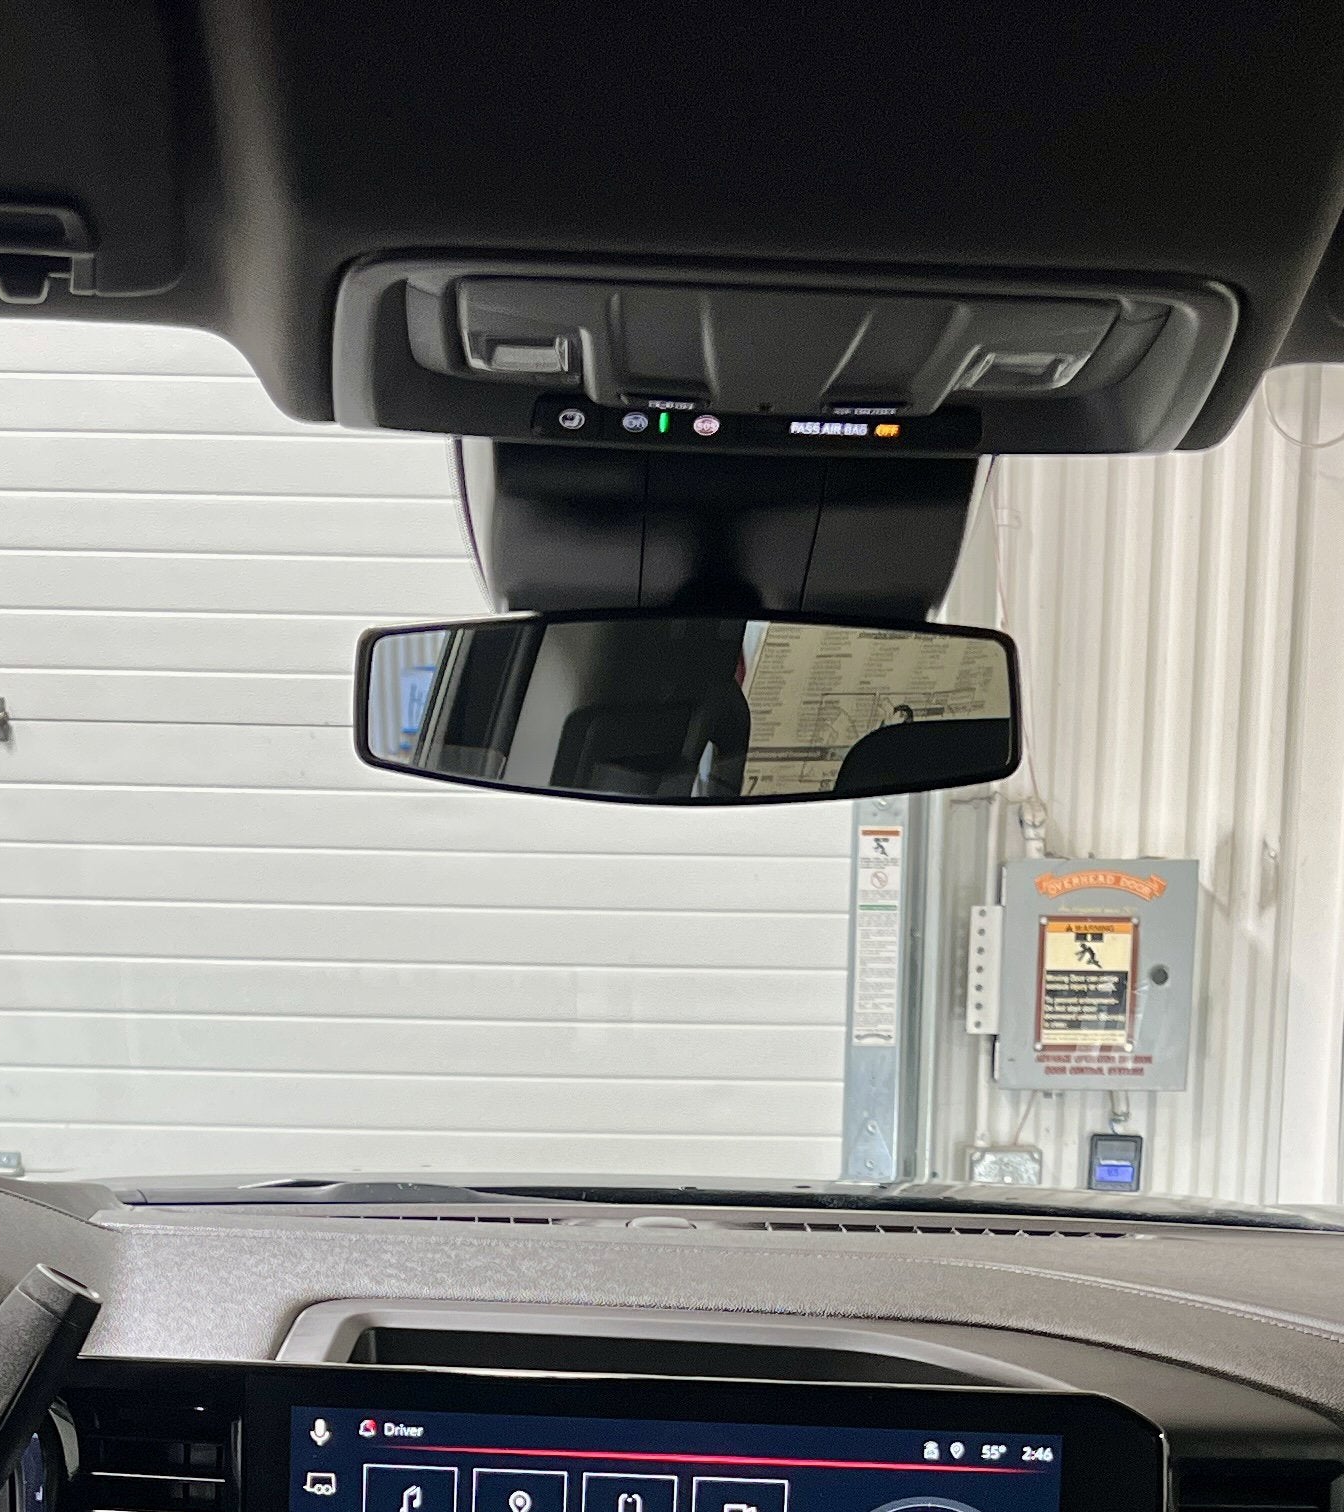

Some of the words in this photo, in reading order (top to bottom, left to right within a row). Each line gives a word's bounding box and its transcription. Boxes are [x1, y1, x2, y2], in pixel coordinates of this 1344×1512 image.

[790, 421, 820, 435] PASS
[821, 423, 842, 435] AIR
[844, 423, 869, 437] BAG
[874, 424, 900, 437] OFF
[1047, 874, 1115, 895] OVERHEAD
[1119, 877, 1153, 897] DOOR
[1074, 924, 1115, 932] WARNING
[384, 1423, 423, 1437] Driver
[1022, 1446, 1054, 1462] 2:46
